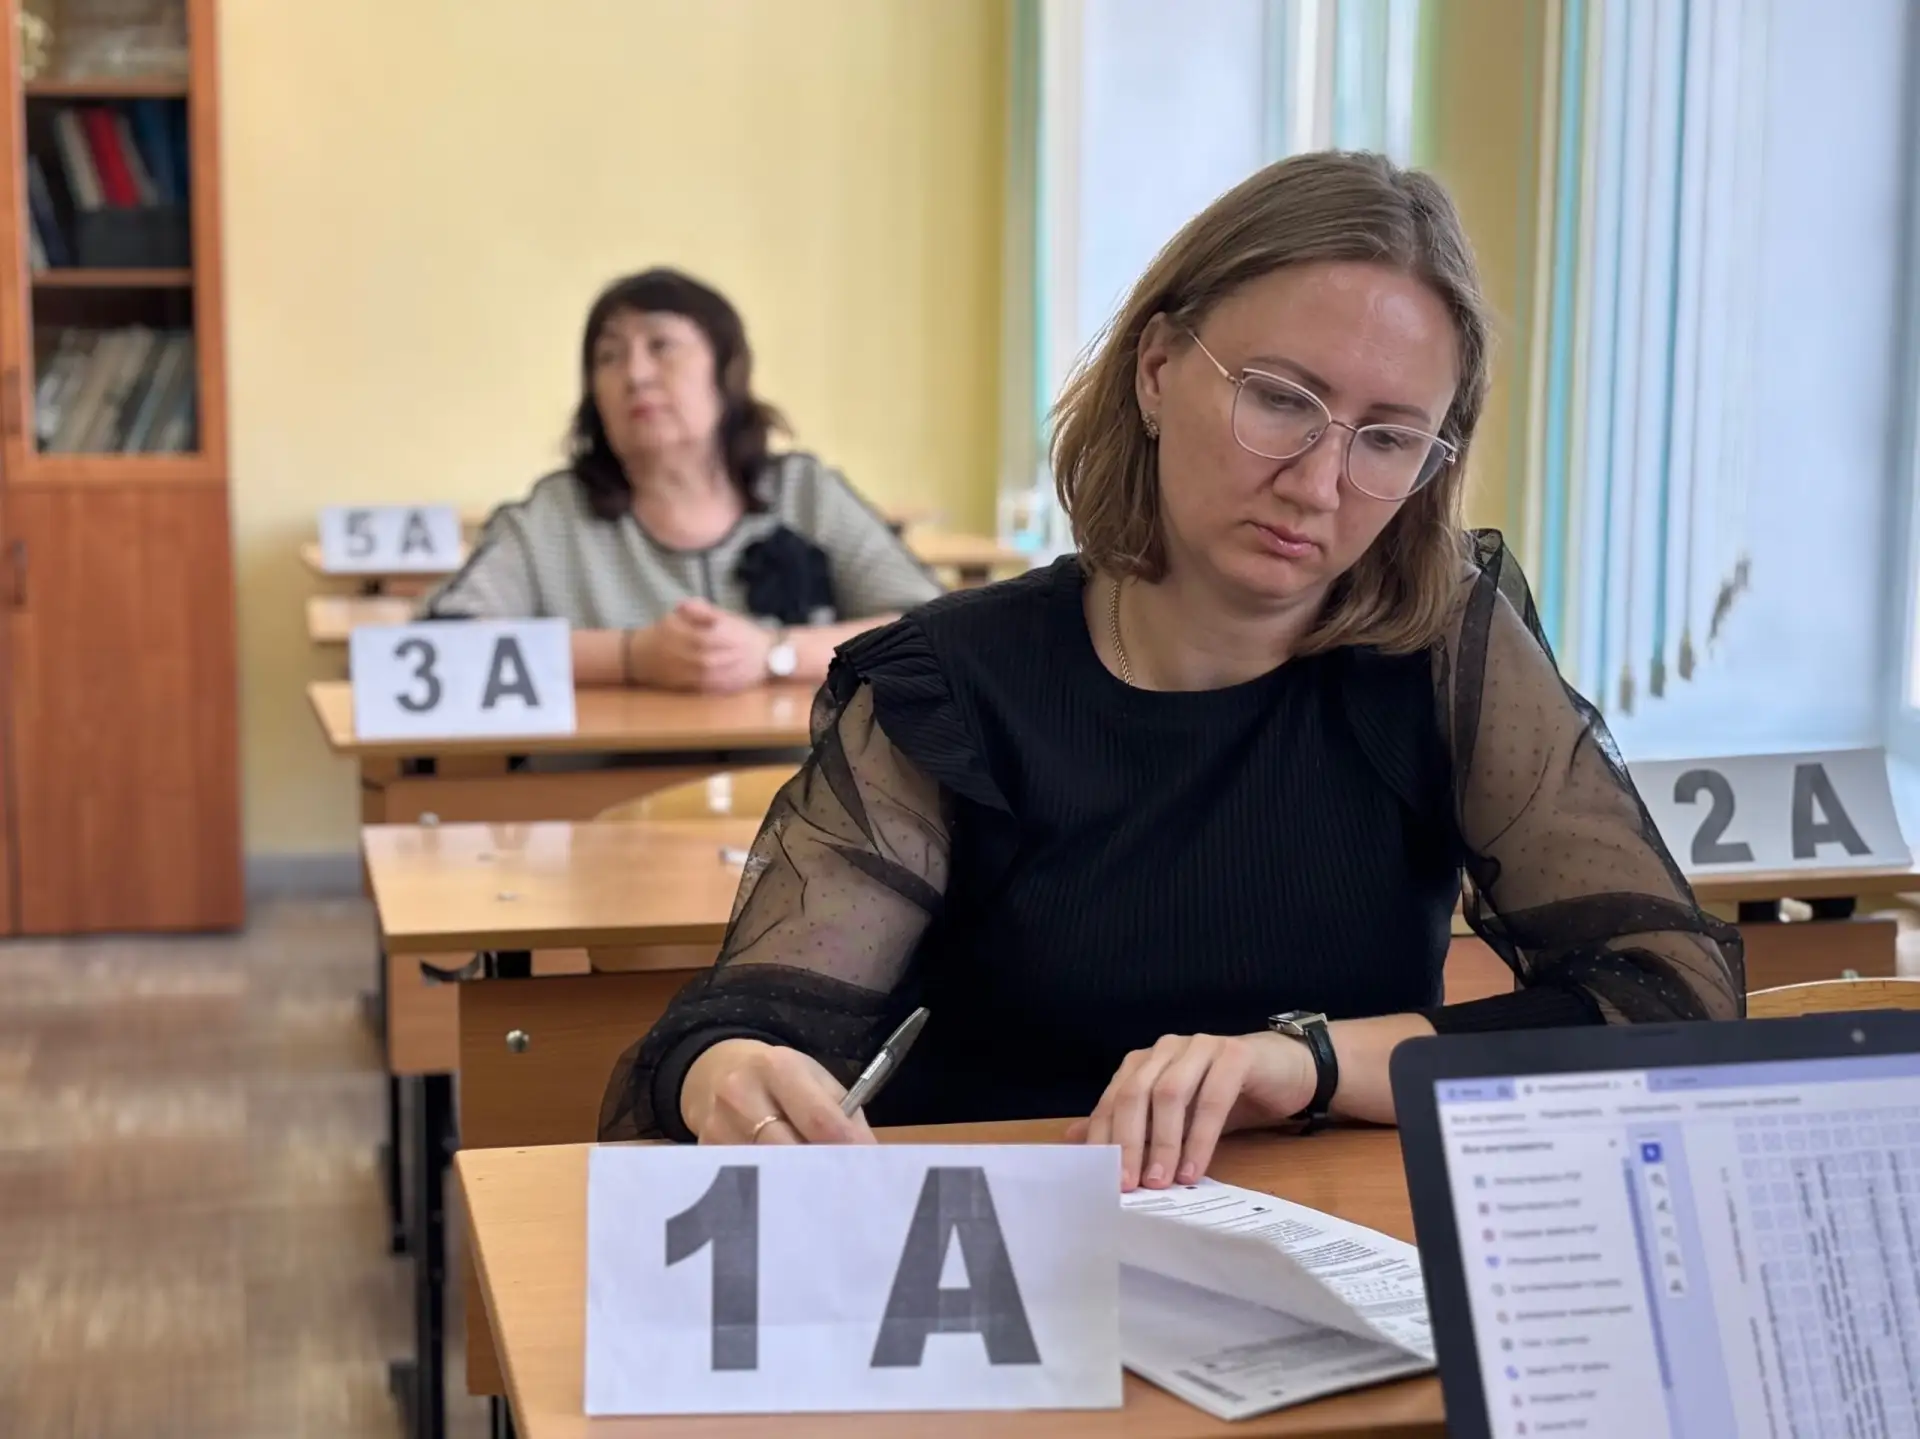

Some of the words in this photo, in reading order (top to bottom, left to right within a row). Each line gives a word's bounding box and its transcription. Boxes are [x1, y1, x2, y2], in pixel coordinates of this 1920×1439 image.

[345, 509, 377, 557] 5
[394, 638, 442, 713] 3
[481, 636, 540, 710] А
[1673, 768, 1755, 865] 2
[1791, 761, 1873, 860] А
[665, 1165, 759, 1371] 1
[870, 1166, 1041, 1368] А
